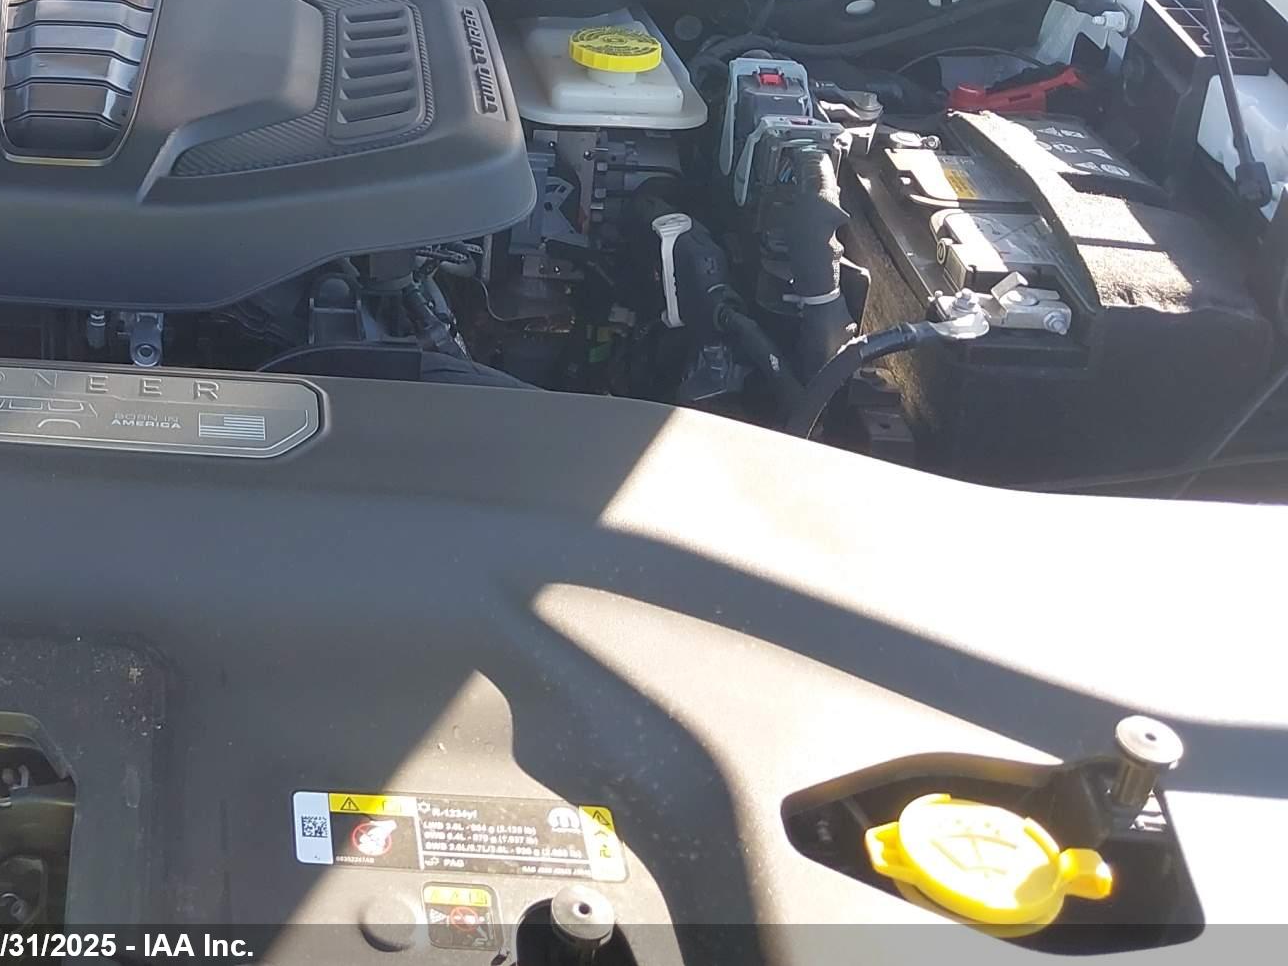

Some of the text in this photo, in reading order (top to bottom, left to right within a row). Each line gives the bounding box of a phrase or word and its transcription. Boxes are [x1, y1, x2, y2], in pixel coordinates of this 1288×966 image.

[462, 7, 498, 113] TWIN TURBO
[111, 419, 182, 429] AMERICA
